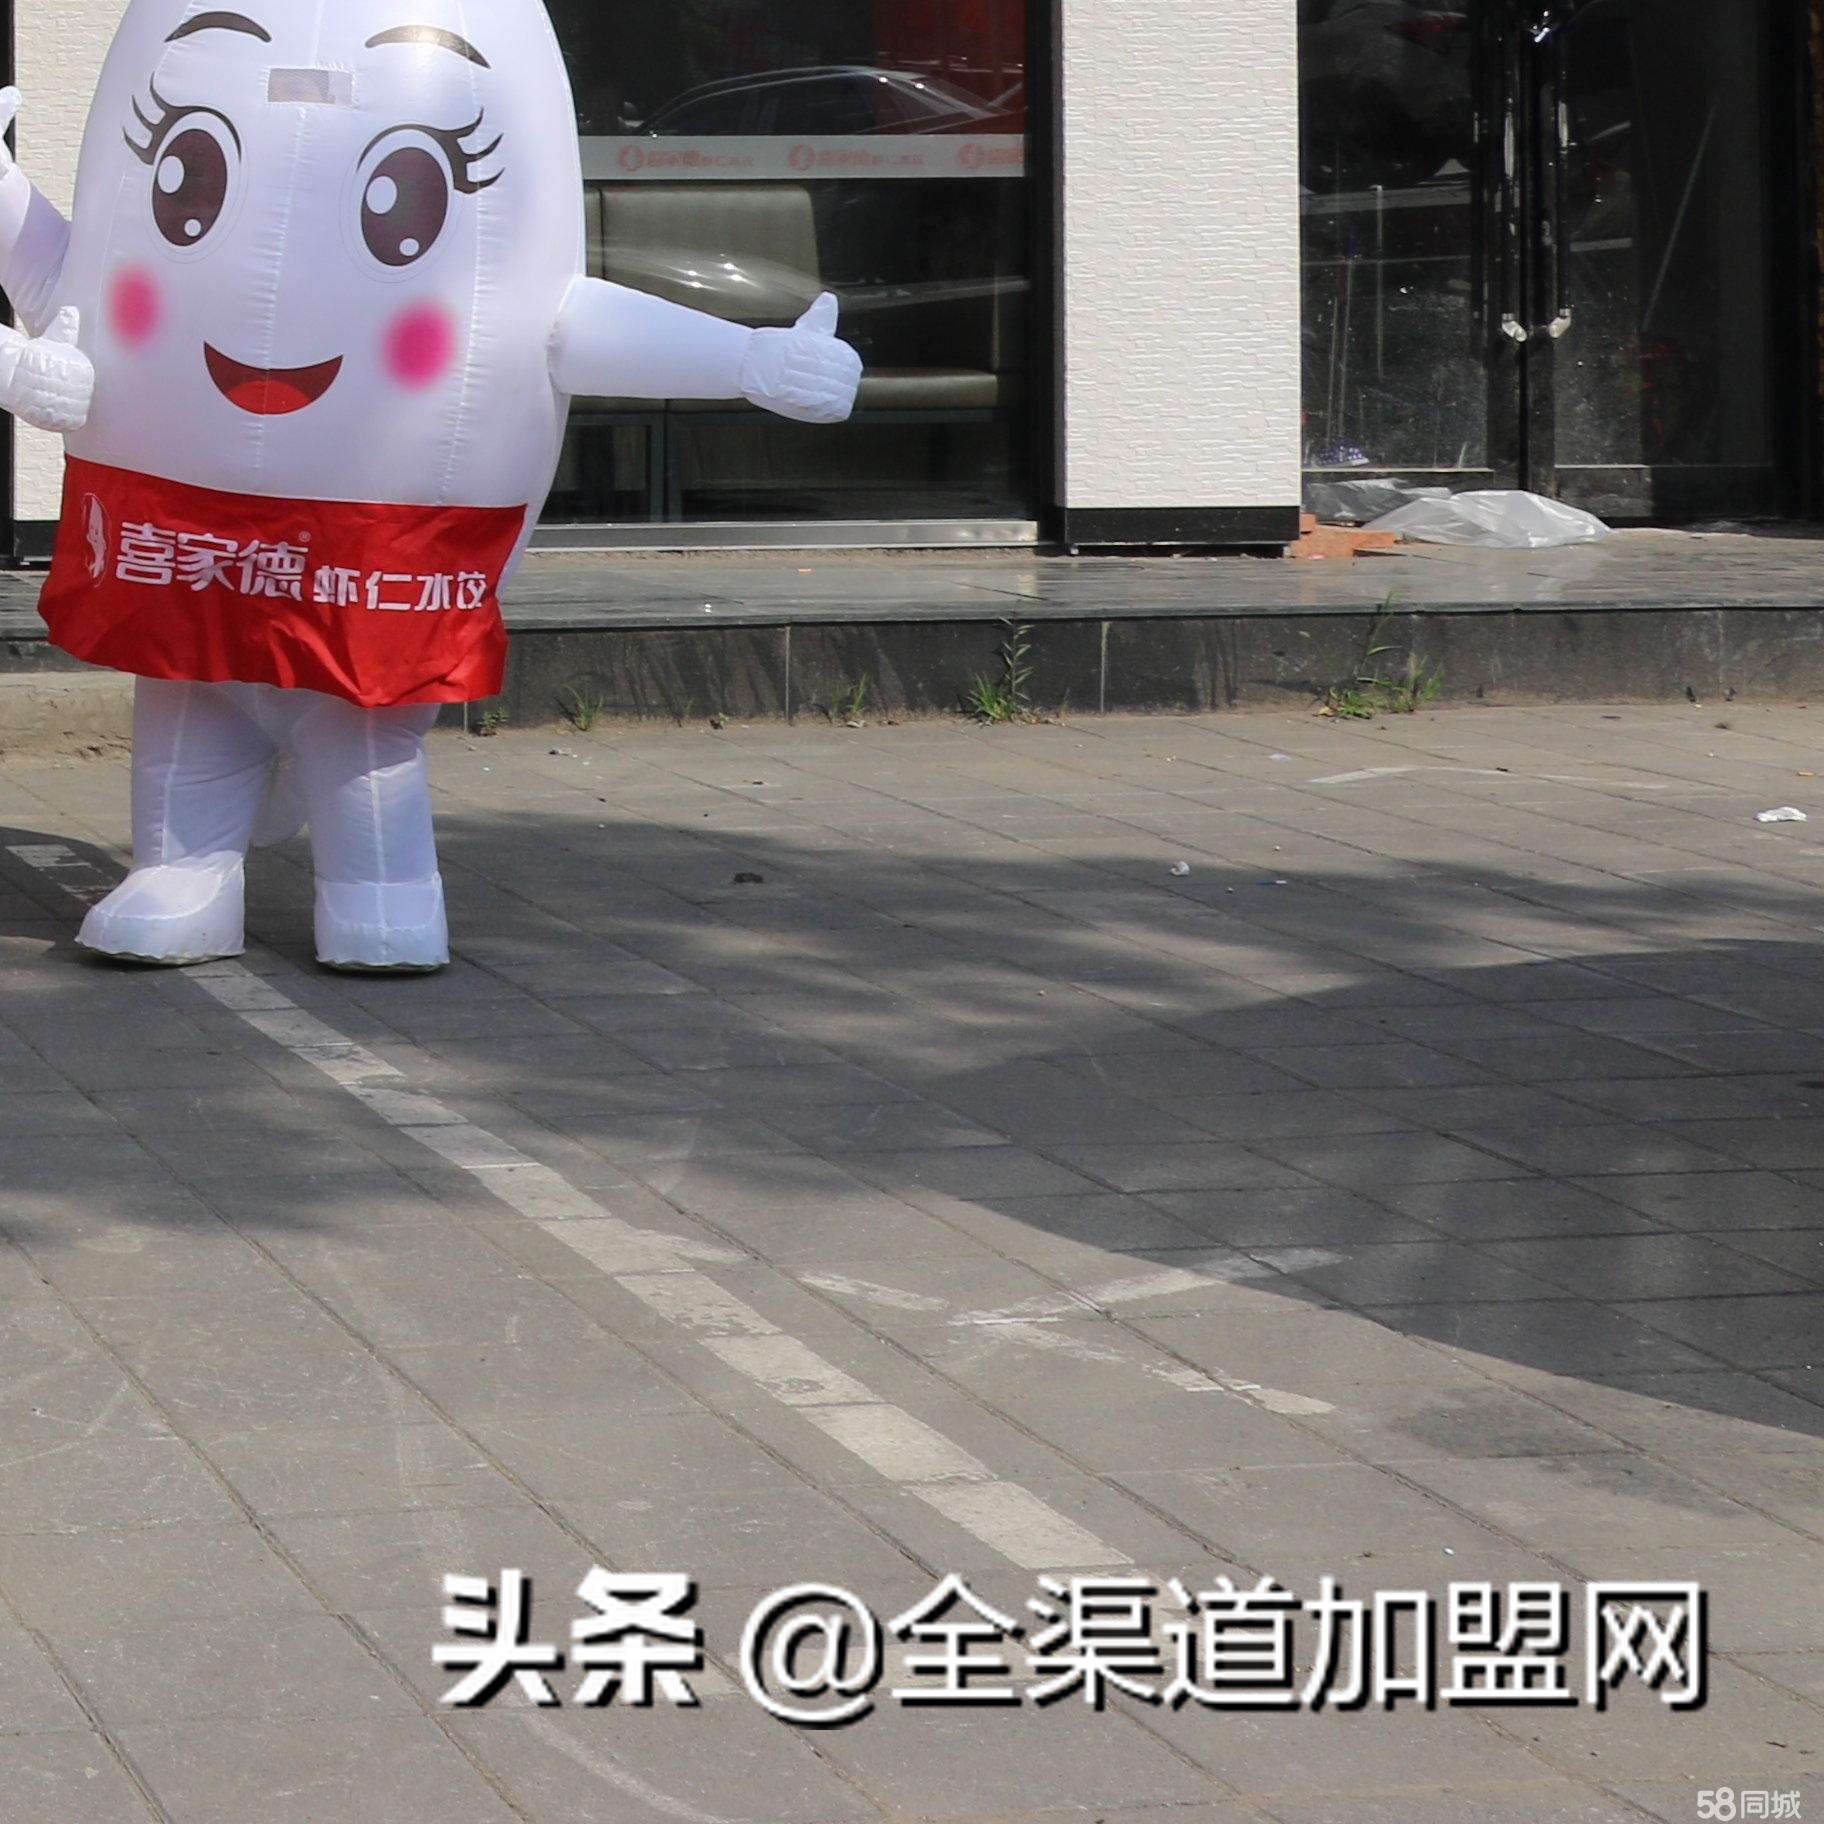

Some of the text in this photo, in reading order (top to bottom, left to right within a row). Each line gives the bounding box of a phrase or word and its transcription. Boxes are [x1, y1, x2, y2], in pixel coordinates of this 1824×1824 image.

[115, 521, 309, 602] 喜家德
[313, 565, 487, 613] 虾仁水饺
